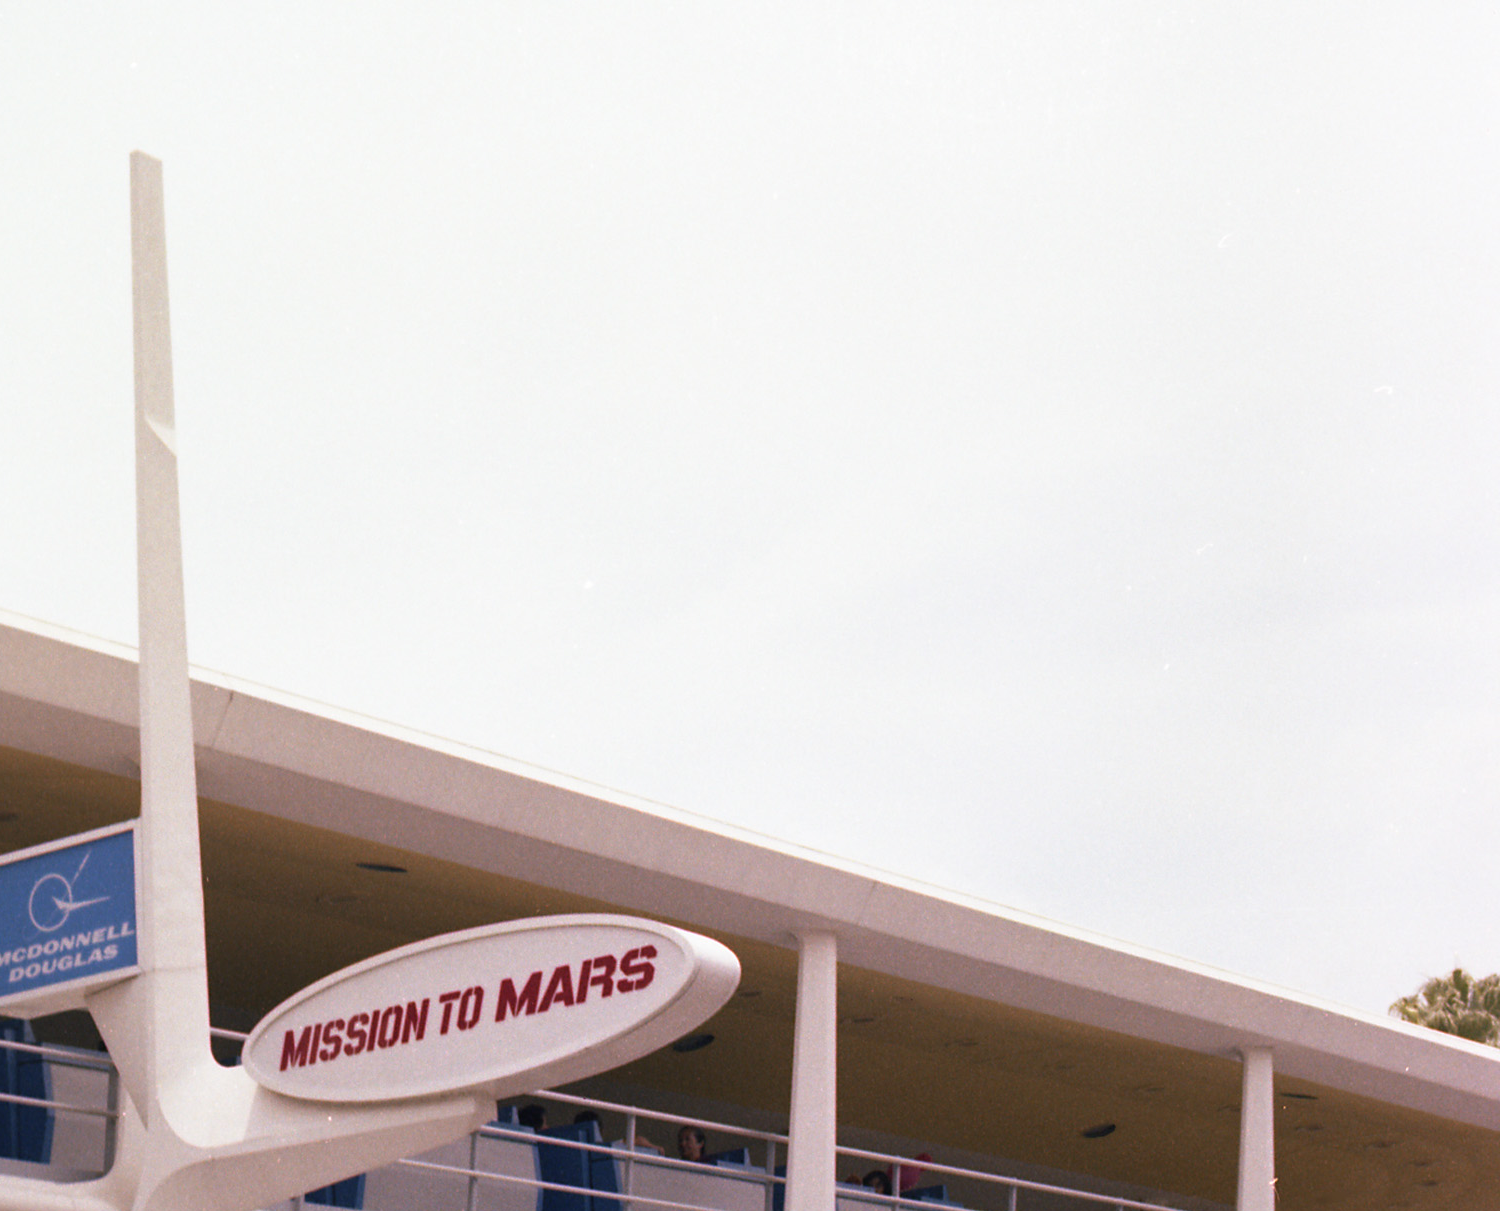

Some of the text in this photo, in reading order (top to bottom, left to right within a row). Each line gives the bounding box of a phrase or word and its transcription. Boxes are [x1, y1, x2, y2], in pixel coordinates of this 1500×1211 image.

[8, 944, 118, 983] DOUGLAS
[279, 944, 658, 1072] MISSION TO MARS
